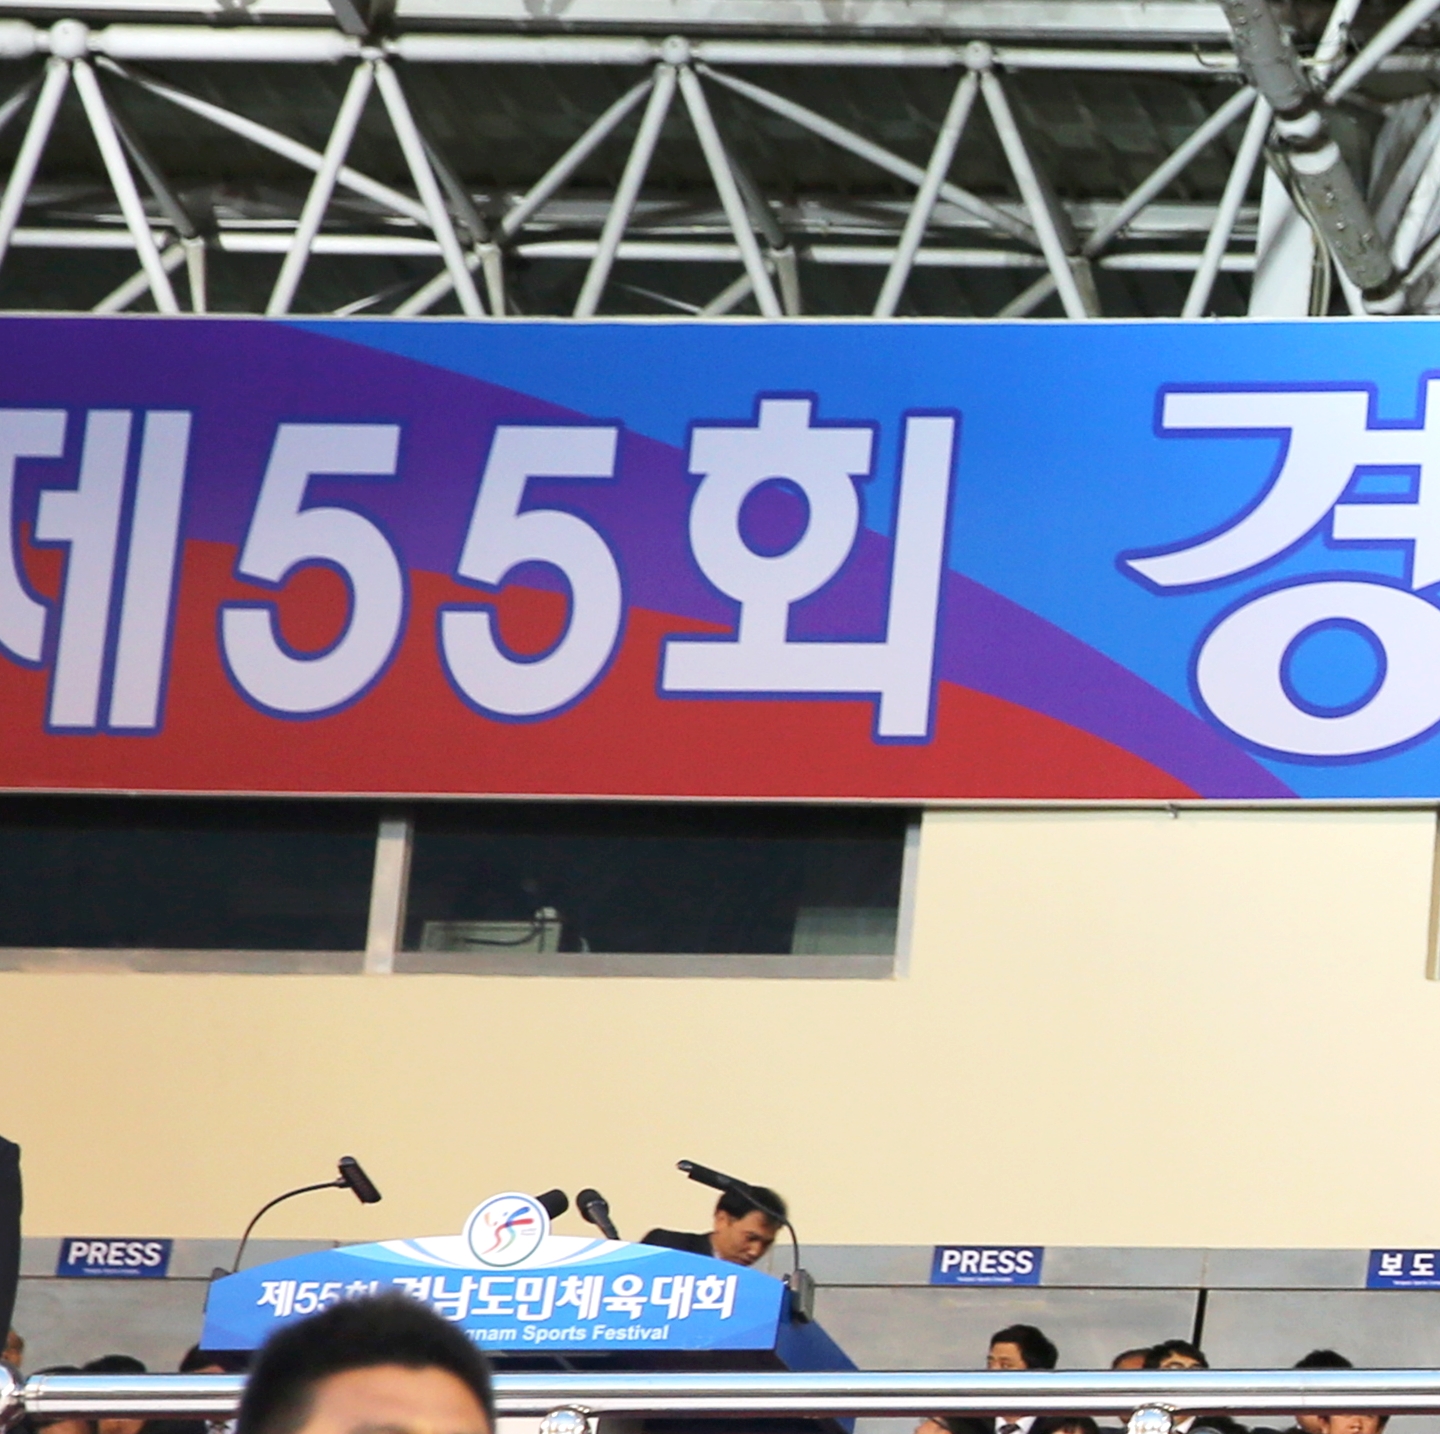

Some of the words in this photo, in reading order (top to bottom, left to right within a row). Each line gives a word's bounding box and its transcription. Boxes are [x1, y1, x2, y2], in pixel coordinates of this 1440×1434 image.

[0, 396, 960, 740] 제55회
[67, 1241, 163, 1267] PRESS
[941, 1249, 1035, 1275] PRESS
[522, 1325, 587, 1344] Sports
[592, 1323, 670, 1341] Festival
